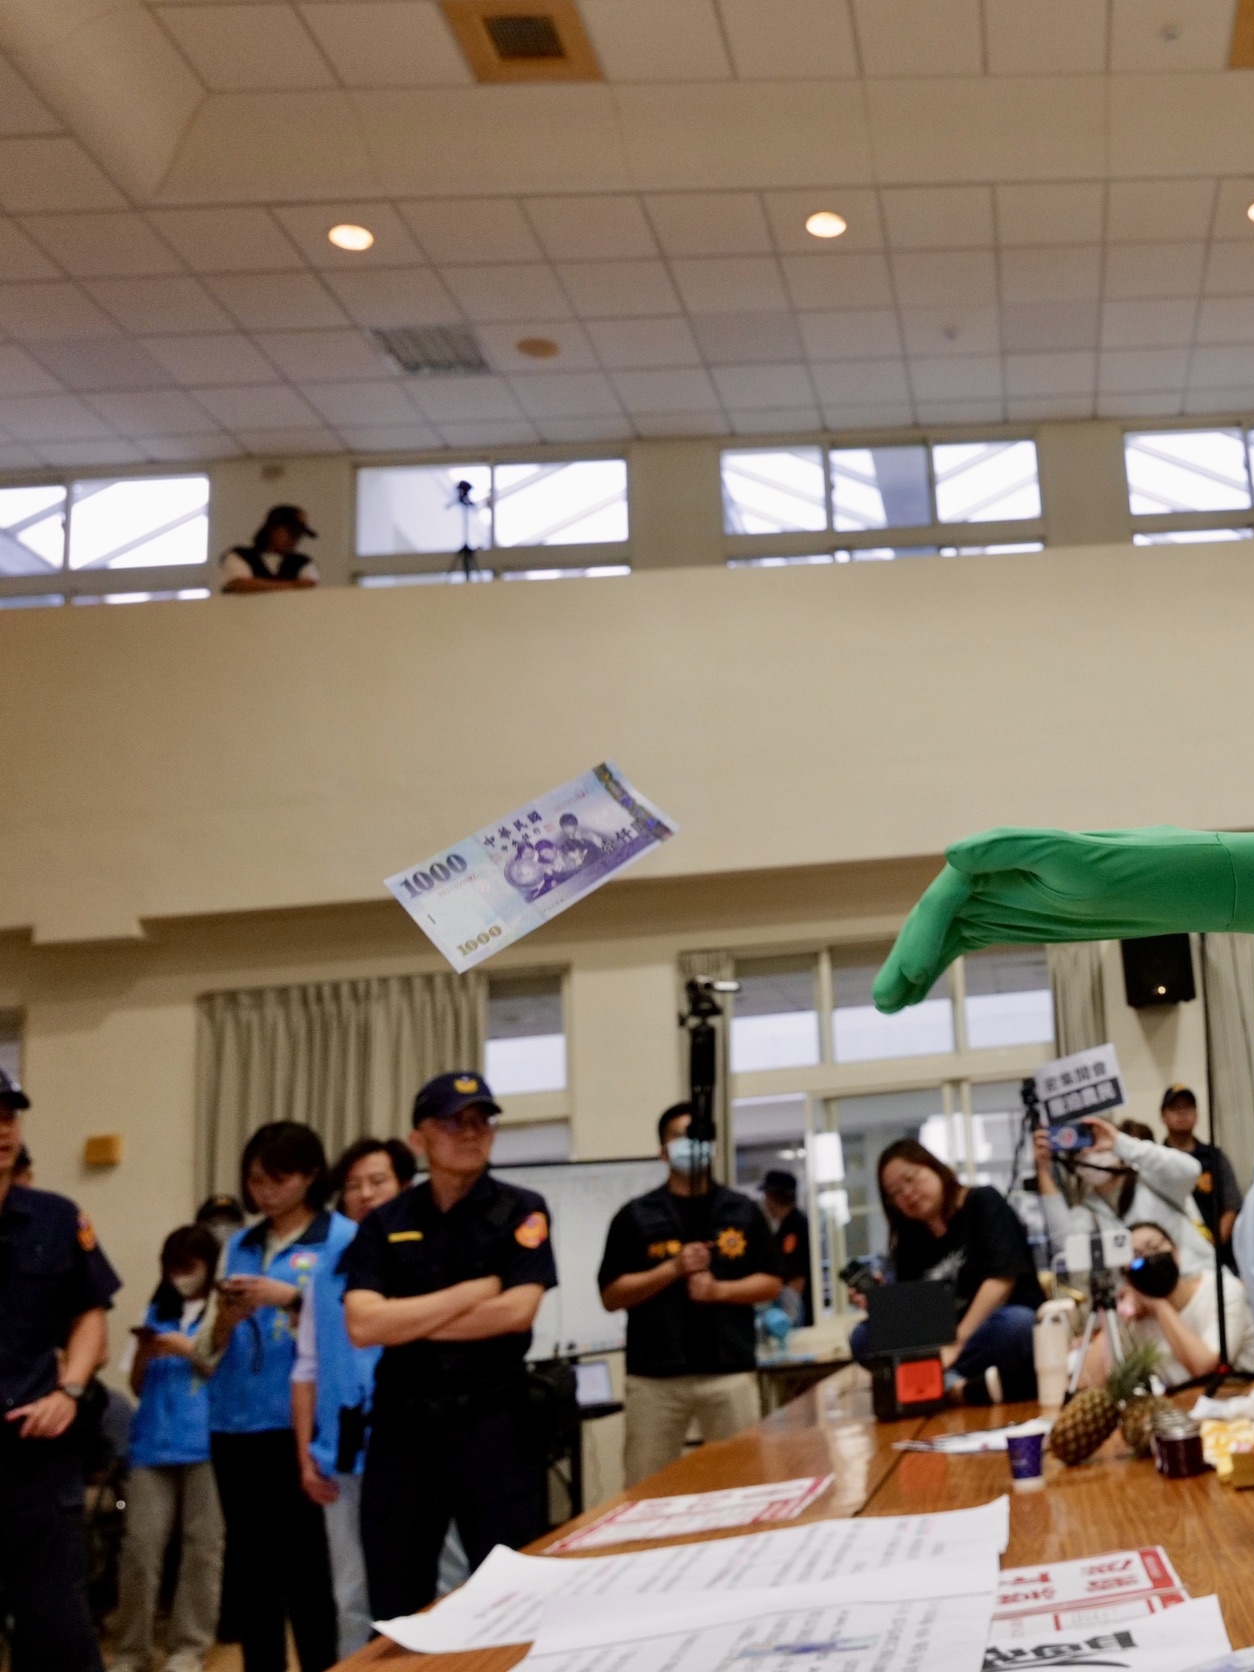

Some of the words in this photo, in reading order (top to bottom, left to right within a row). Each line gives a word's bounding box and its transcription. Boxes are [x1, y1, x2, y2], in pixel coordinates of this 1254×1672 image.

[483, 811, 542, 848] 中華民國
[400, 853, 468, 898] 1000
[457, 925, 503, 957] 1000
